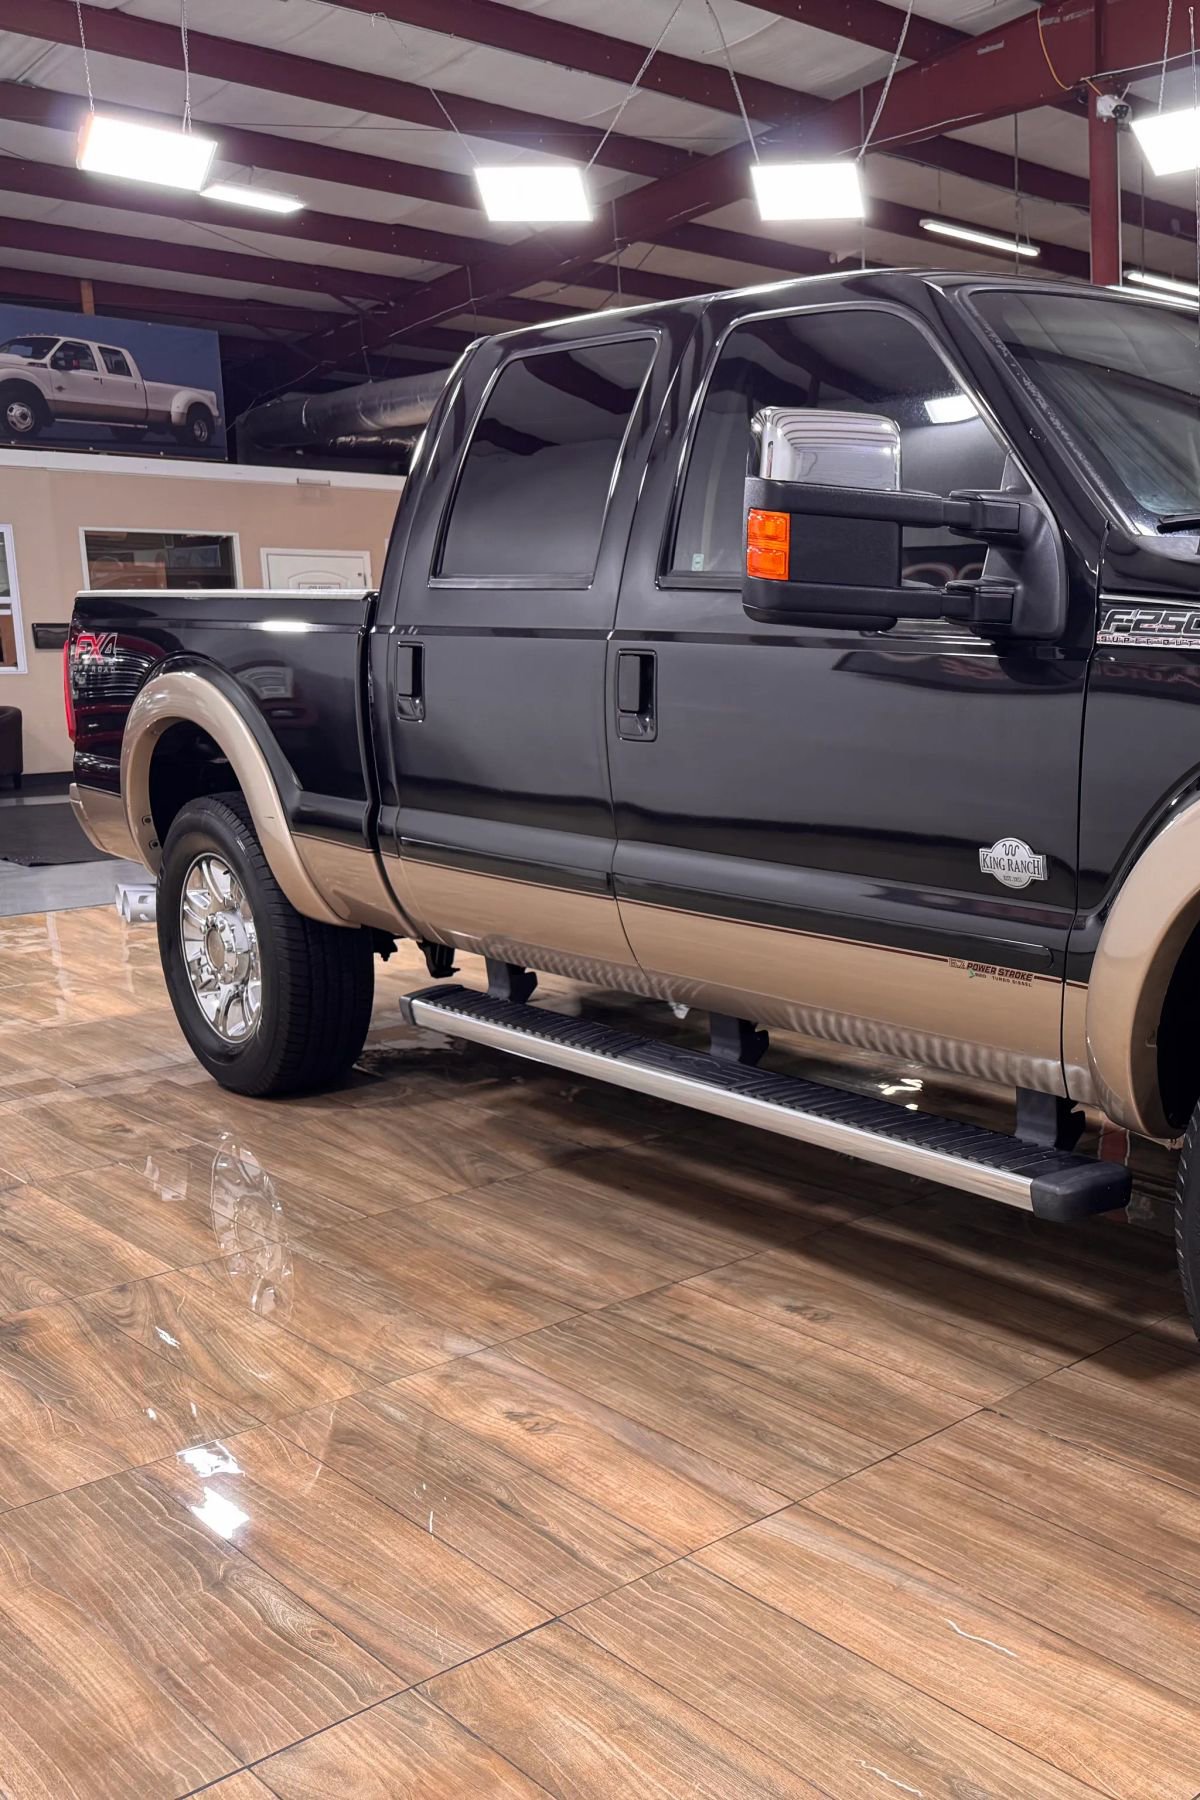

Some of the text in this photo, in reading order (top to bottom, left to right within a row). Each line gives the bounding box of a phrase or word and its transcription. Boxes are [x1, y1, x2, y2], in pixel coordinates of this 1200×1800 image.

[74, 632, 118, 665] FX4
[1100, 635, 1152, 646] SUPER
[982, 853, 1041, 876] KING RANCH
[967, 962, 997, 975] POWER
[997, 968, 1034, 982] STROKE
